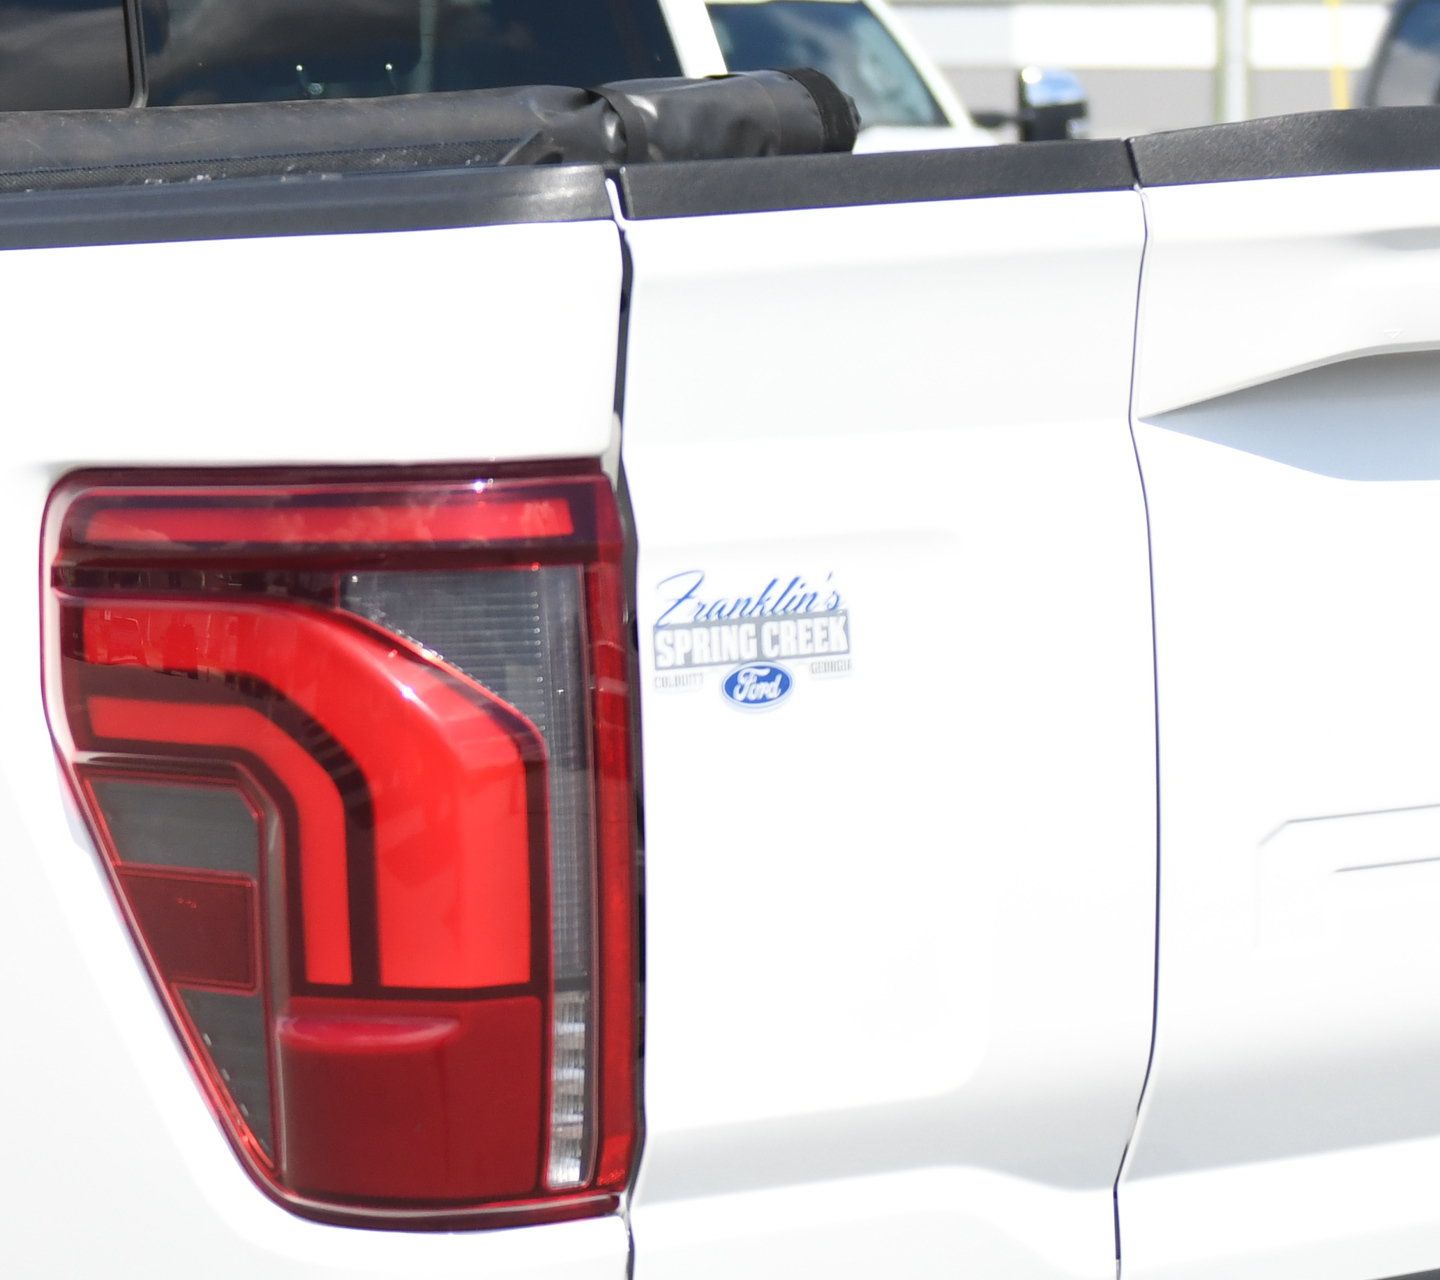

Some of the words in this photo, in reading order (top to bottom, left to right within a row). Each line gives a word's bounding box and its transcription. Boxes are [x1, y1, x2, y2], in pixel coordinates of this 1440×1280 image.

[654, 570, 841, 629] Franklin's
[654, 623, 757, 669] SPRING
[760, 615, 850, 659] CREEK
[732, 668, 783, 702] Ford
